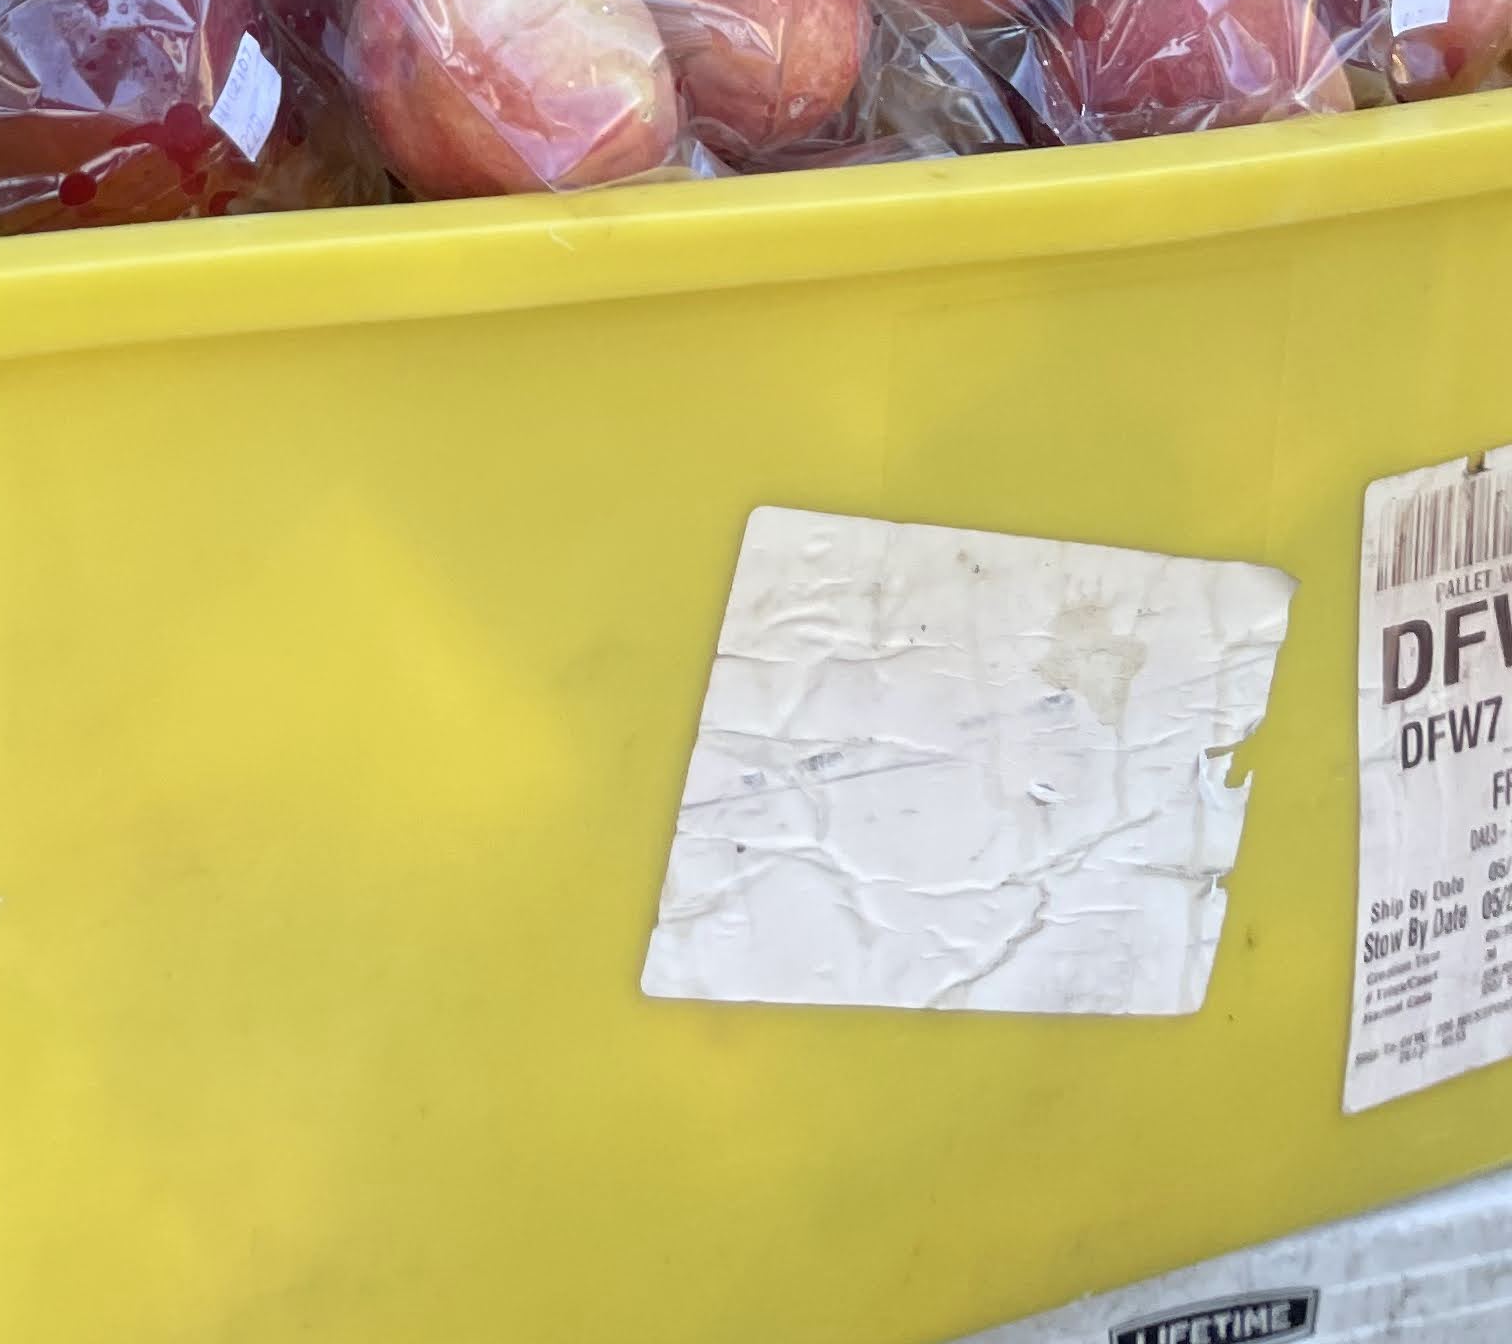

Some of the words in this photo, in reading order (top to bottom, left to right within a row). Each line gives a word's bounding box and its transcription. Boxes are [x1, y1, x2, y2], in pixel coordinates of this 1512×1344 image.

[1400, 695, 1503, 770] DFW7
[1370, 898, 1404, 925] Ship
[1409, 888, 1428, 911] By
[1432, 875, 1465, 902] Date
[1408, 916, 1429, 951] By
[1432, 903, 1468, 938] Date
